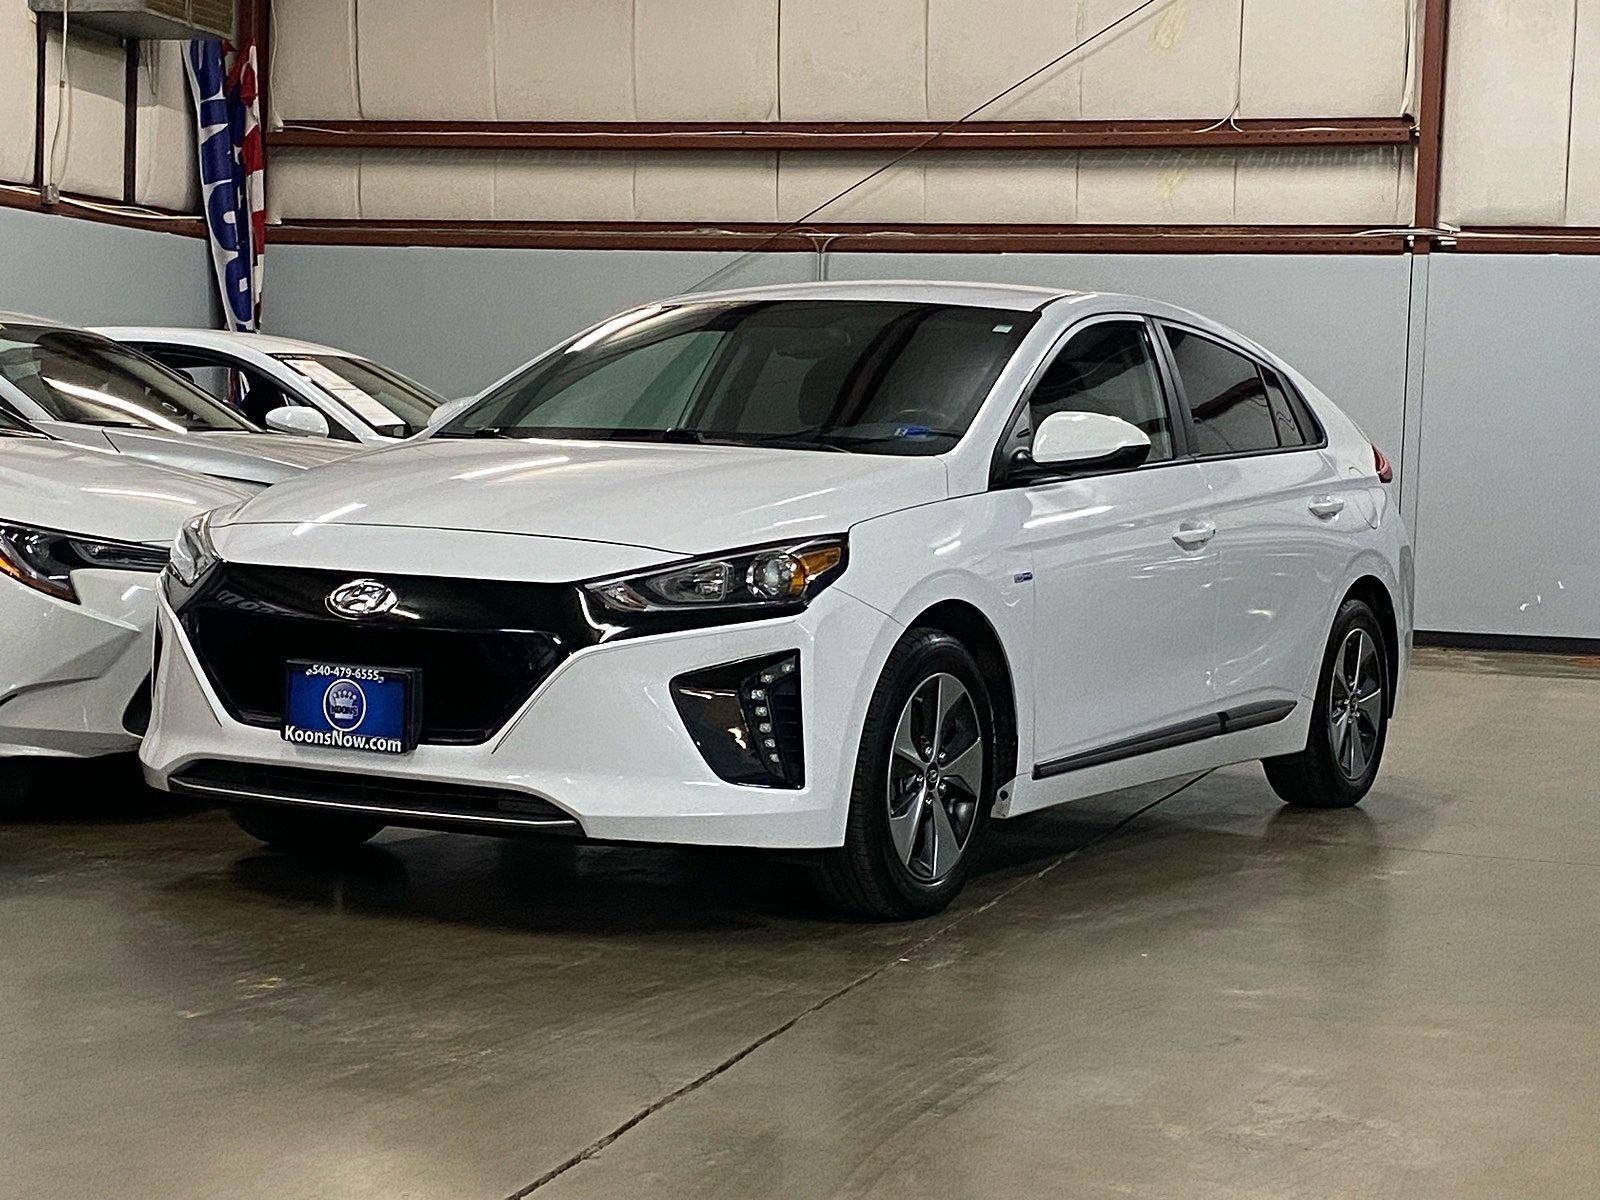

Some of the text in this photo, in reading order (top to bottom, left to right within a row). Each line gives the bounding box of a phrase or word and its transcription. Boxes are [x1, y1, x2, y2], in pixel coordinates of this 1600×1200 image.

[312, 664, 379, 681] 540-479-6555
[331, 705, 358, 716] KOONS
[285, 725, 402, 752] KoonsNow.com
